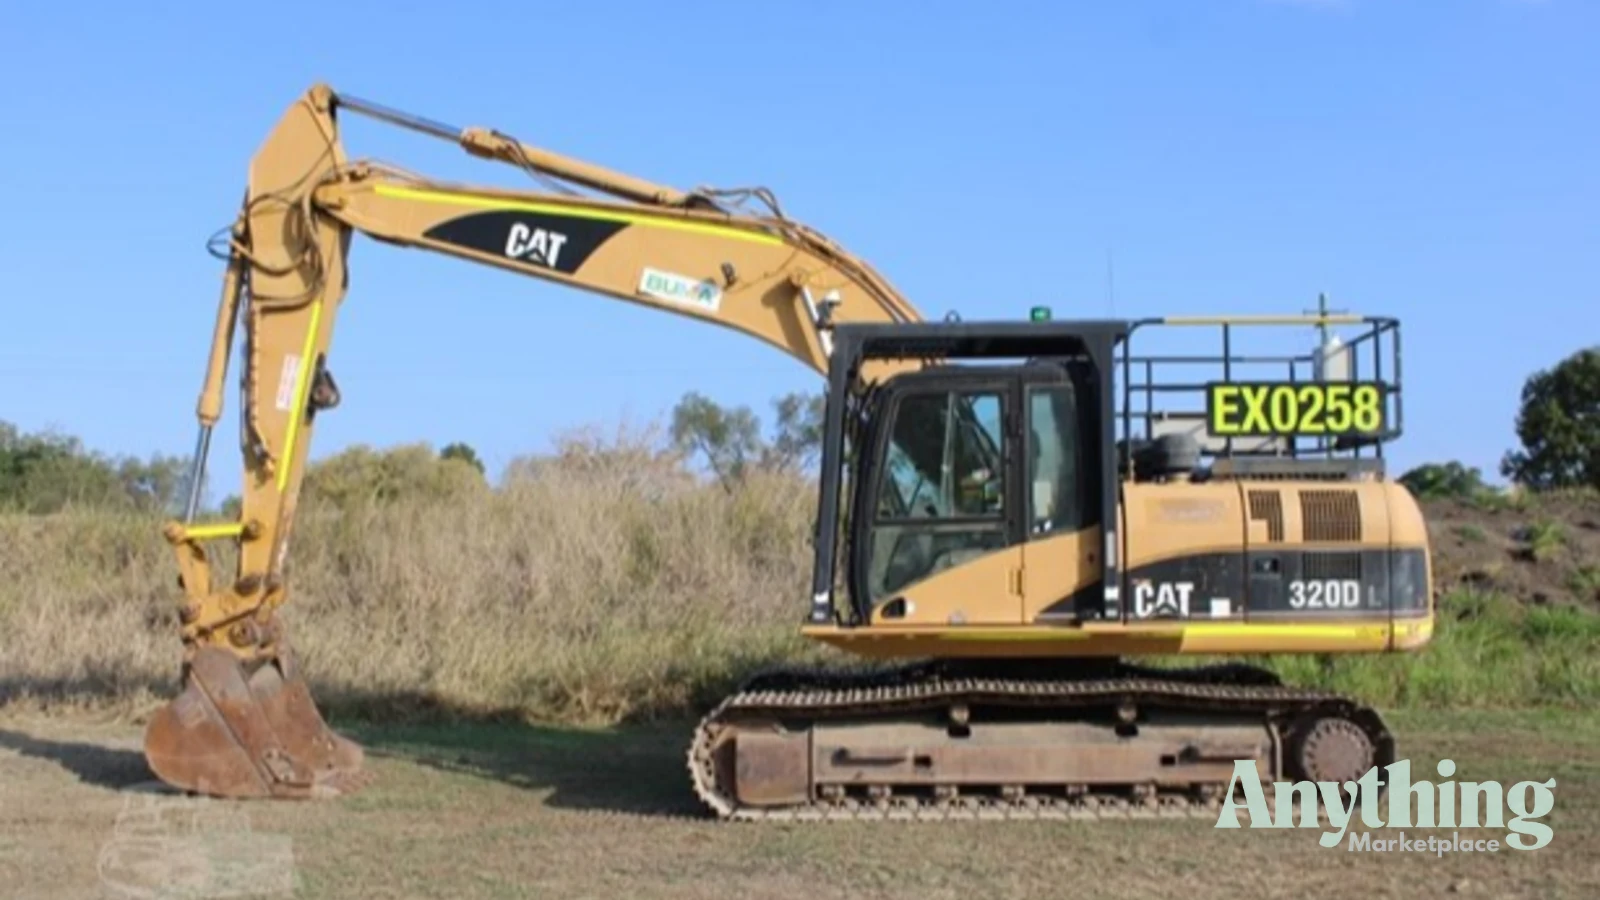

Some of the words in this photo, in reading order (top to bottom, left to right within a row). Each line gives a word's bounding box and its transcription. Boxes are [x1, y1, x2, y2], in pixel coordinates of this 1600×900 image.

[505, 222, 567, 268] CAT
[1212, 385, 1381, 434] EX0258
[1135, 582, 1193, 617] CAT
[1289, 581, 1360, 608] 320D
